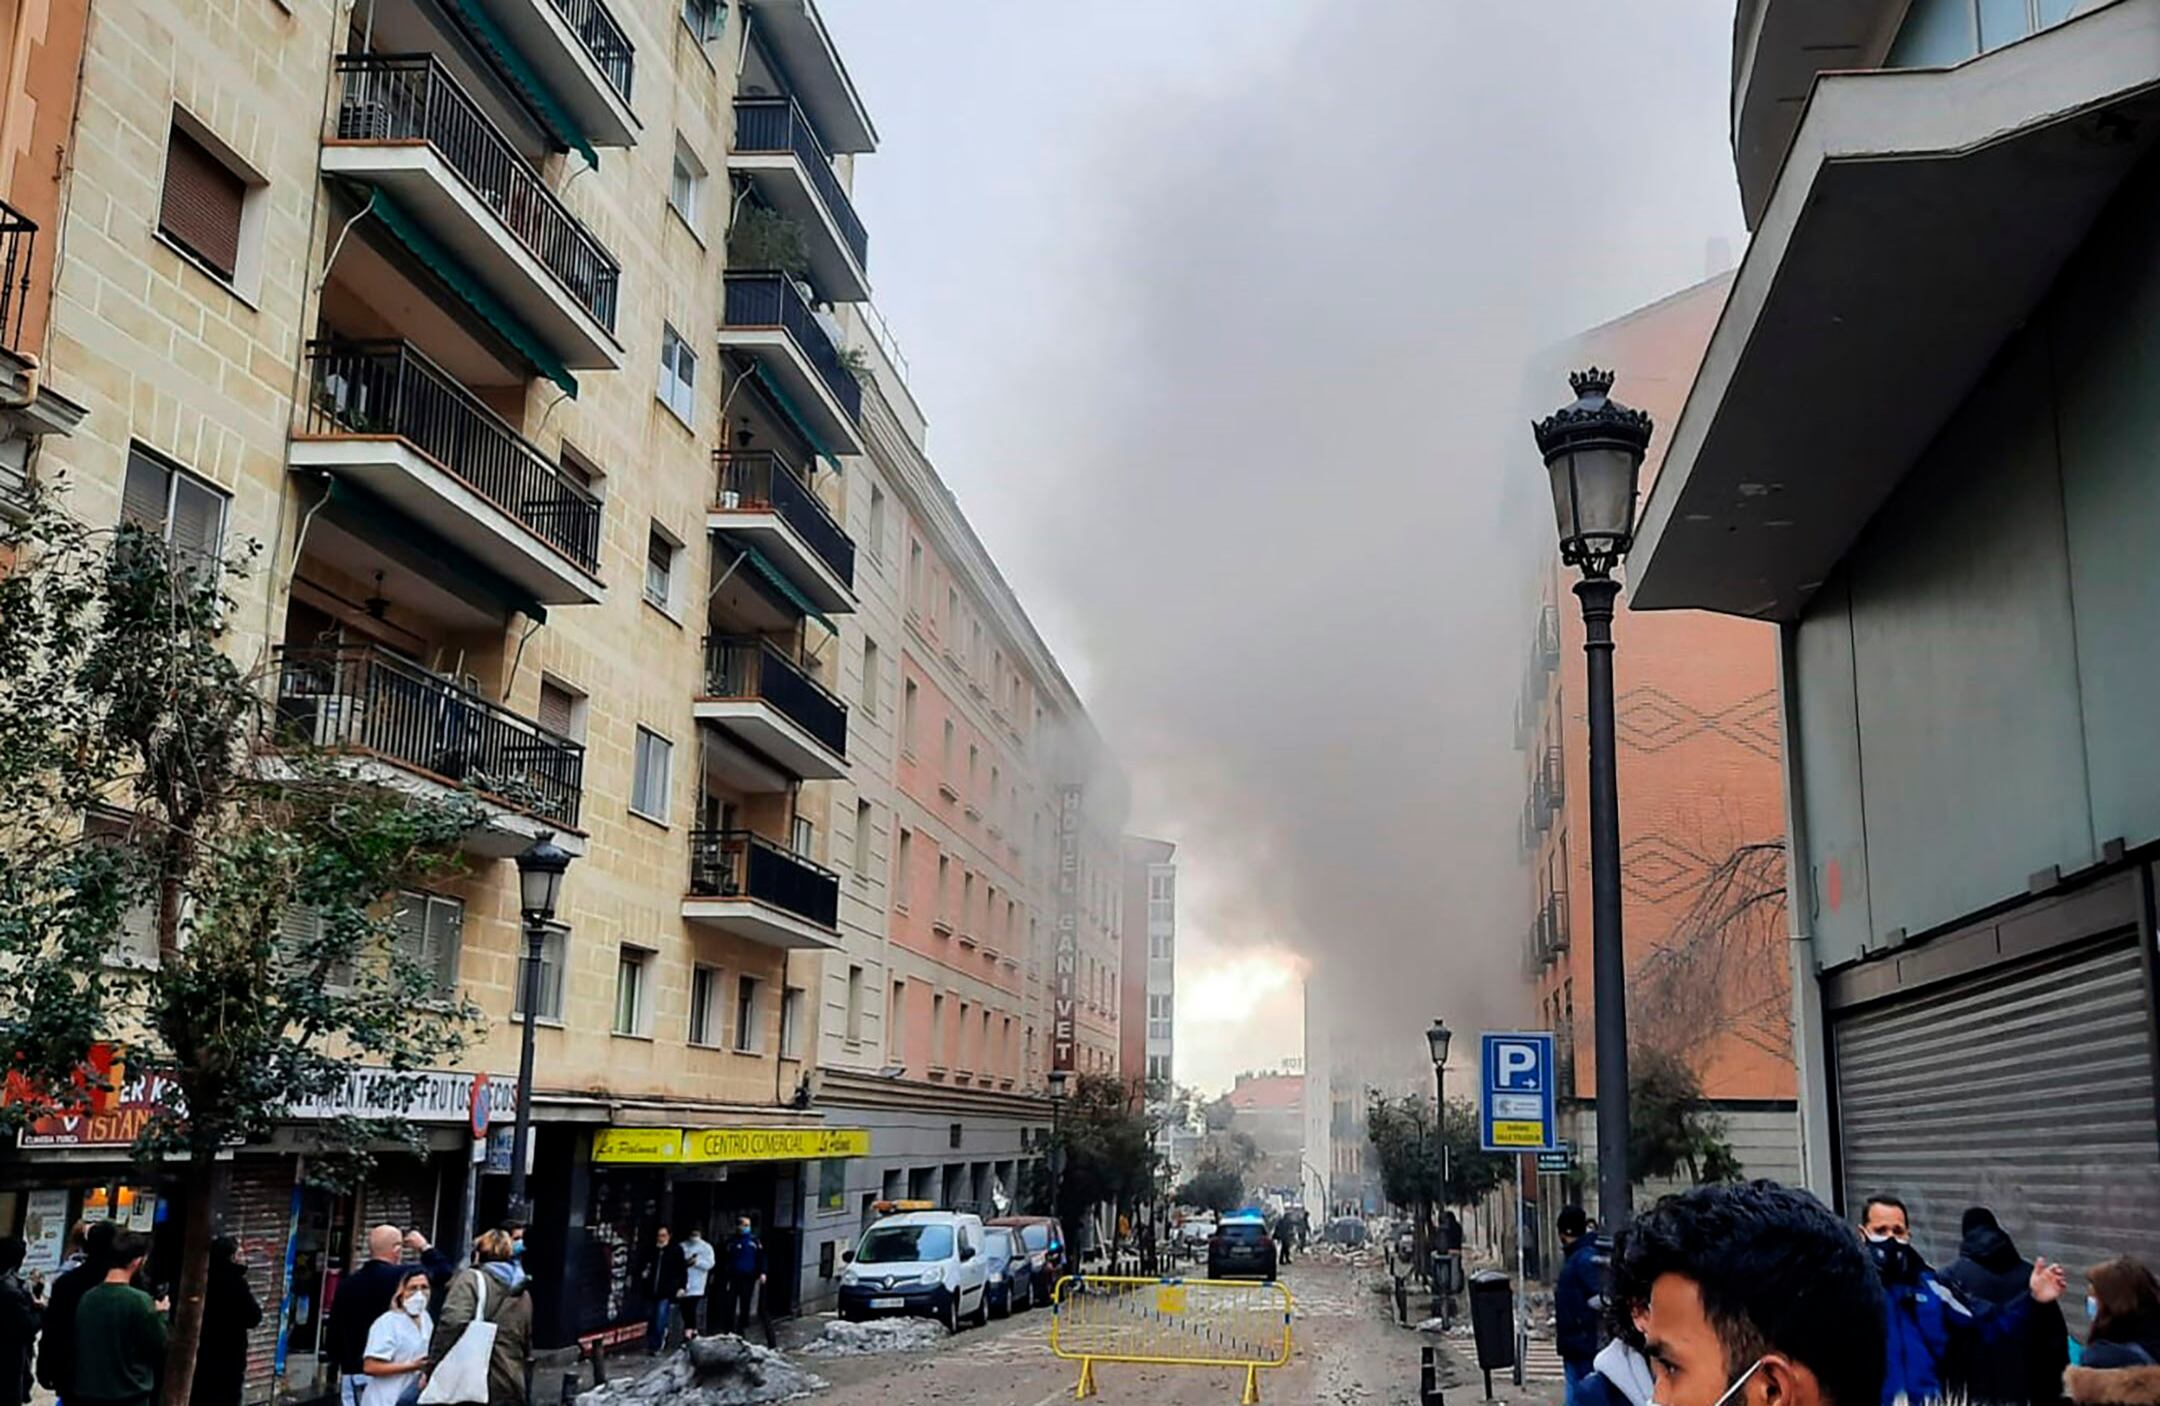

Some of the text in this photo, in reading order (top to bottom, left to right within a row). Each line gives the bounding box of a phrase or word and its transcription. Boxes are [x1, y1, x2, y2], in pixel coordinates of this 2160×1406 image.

[1061, 791, 1080, 894] HOTEL
[1056, 914, 1075, 1061] GANIVET
[1498, 1044, 1537, 1087] P
[704, 1134, 749, 1156] CENTRO
[750, 1132, 804, 1154] COMERCIAL
